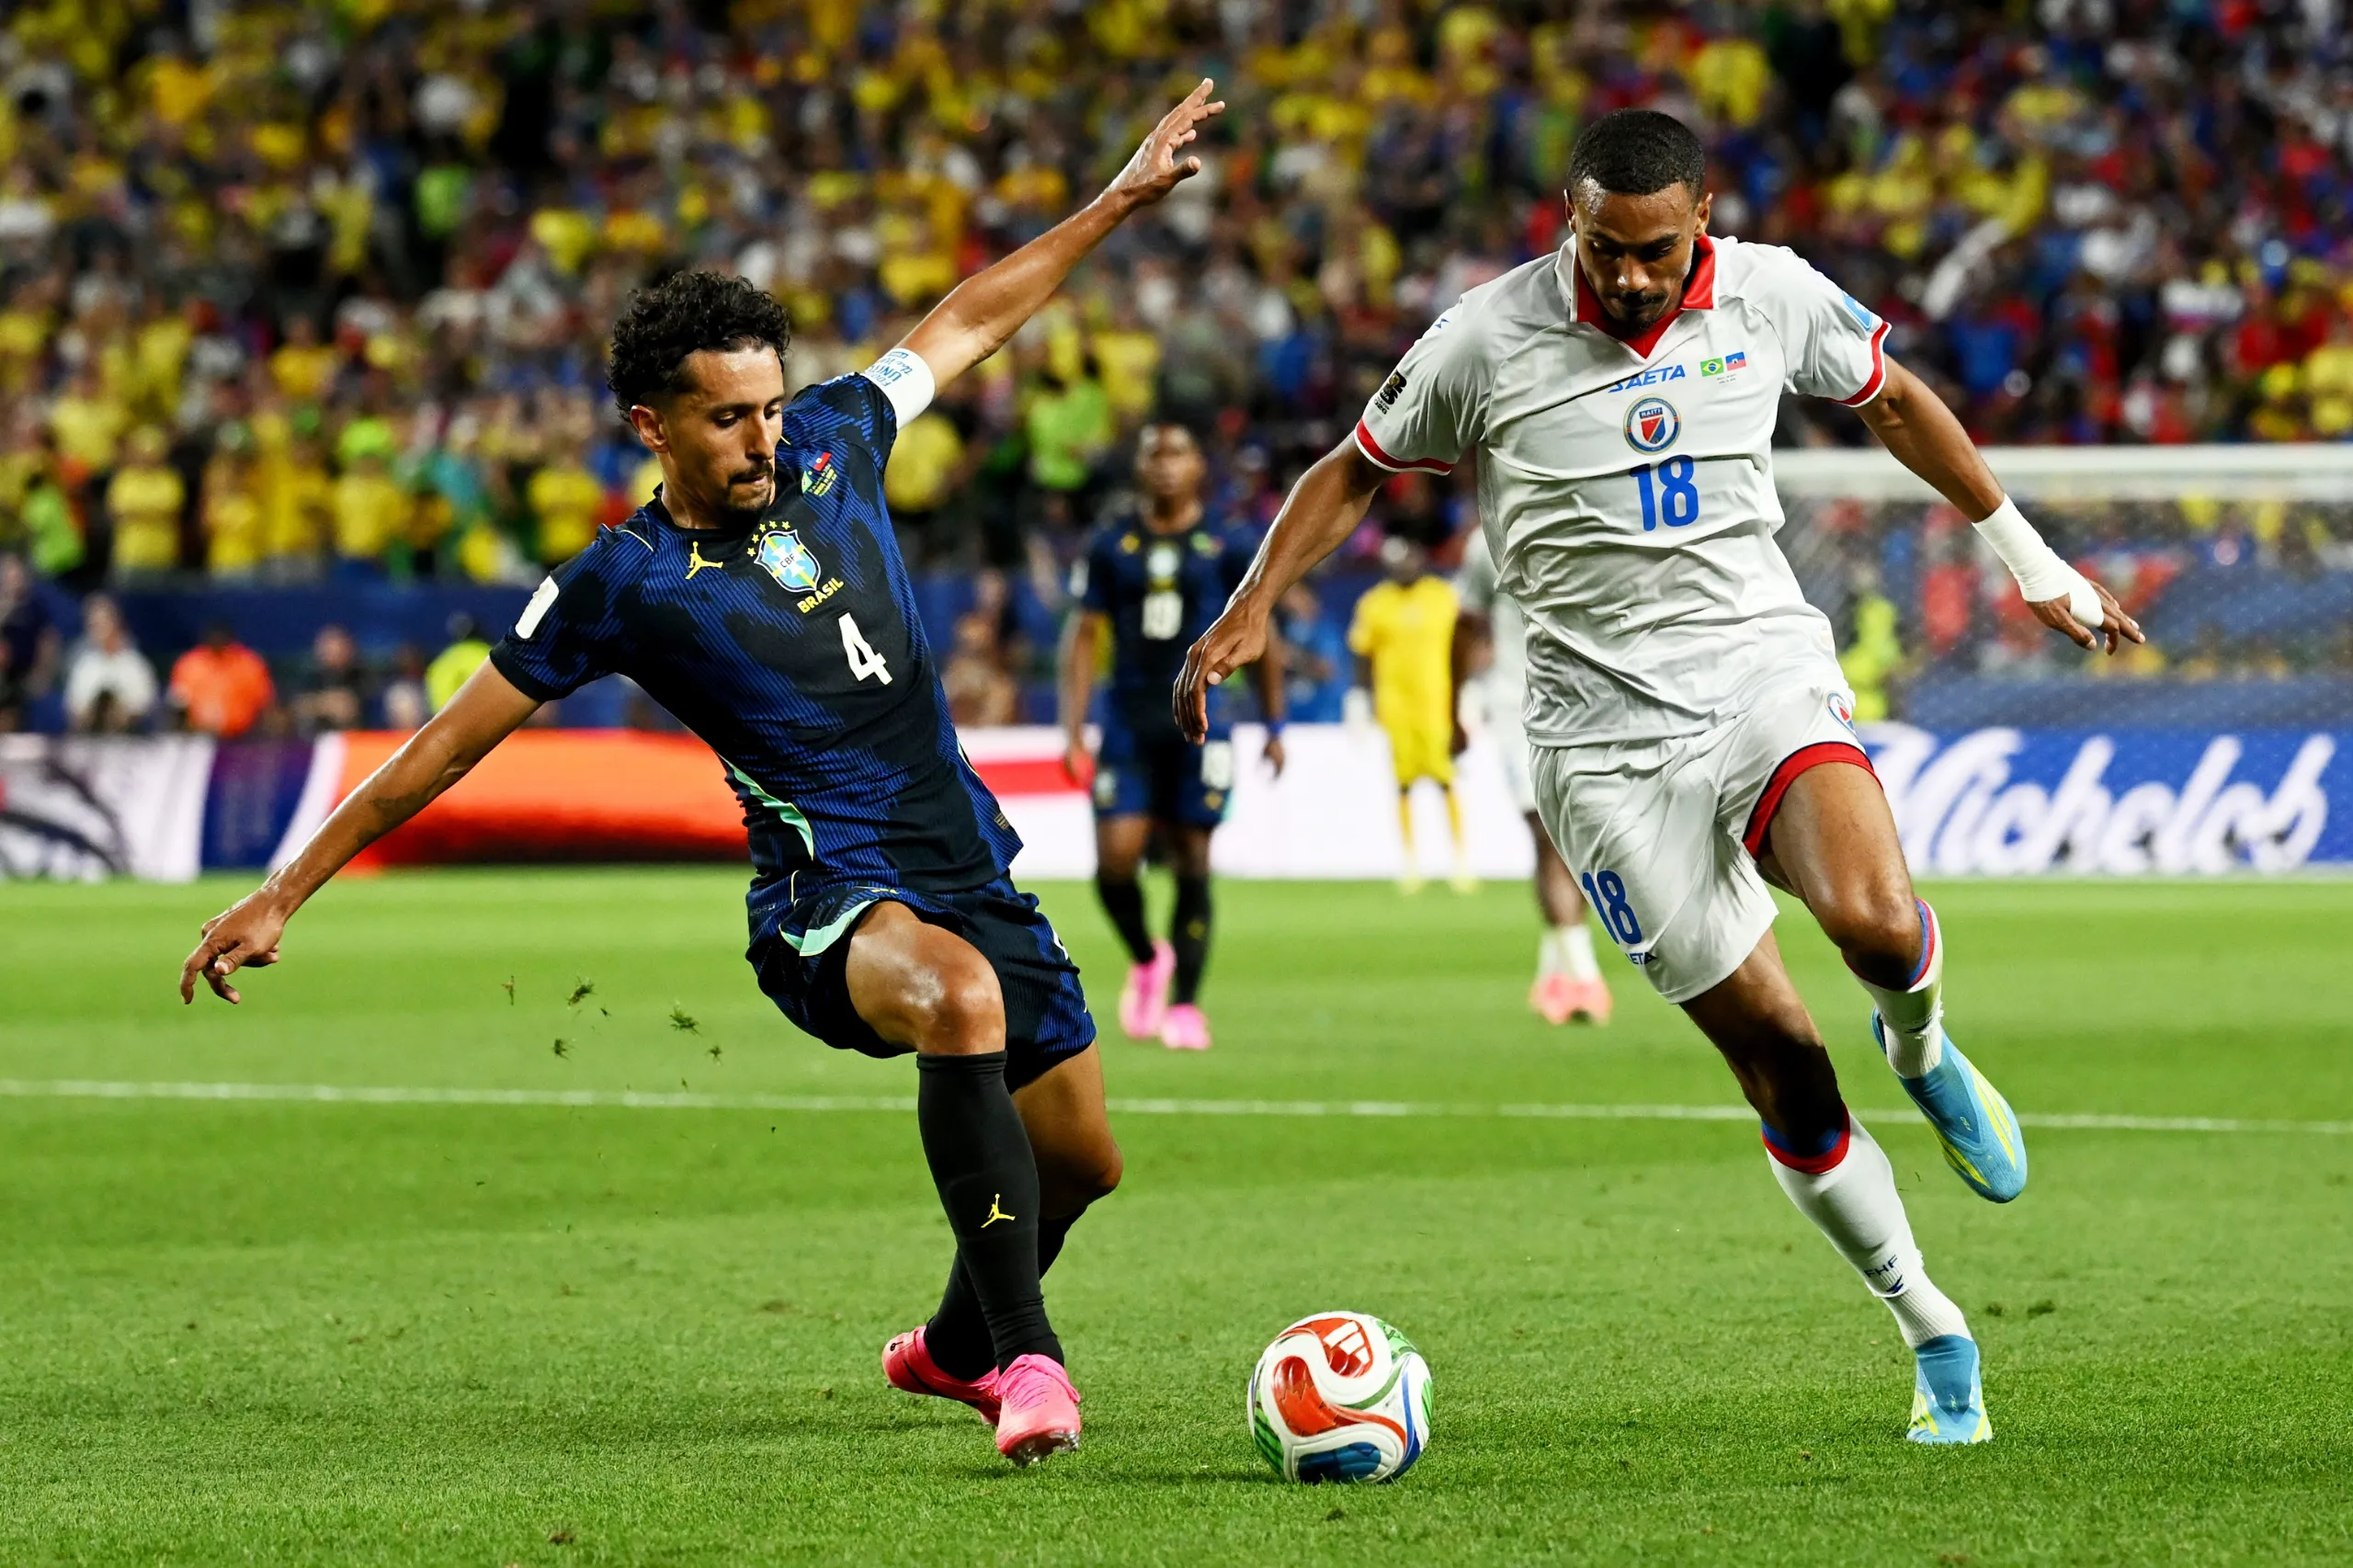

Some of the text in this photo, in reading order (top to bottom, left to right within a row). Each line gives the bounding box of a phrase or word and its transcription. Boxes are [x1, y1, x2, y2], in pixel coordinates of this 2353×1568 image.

[1629, 454, 1699, 532] 18
[779, 552, 796, 568] CBF
[796, 577, 845, 614] BRASIL
[837, 612, 893, 686] 4
[1855, 721, 2336, 877] Michelob
[1582, 869, 1643, 945] 18
[1863, 1254, 1898, 1278] FHF
